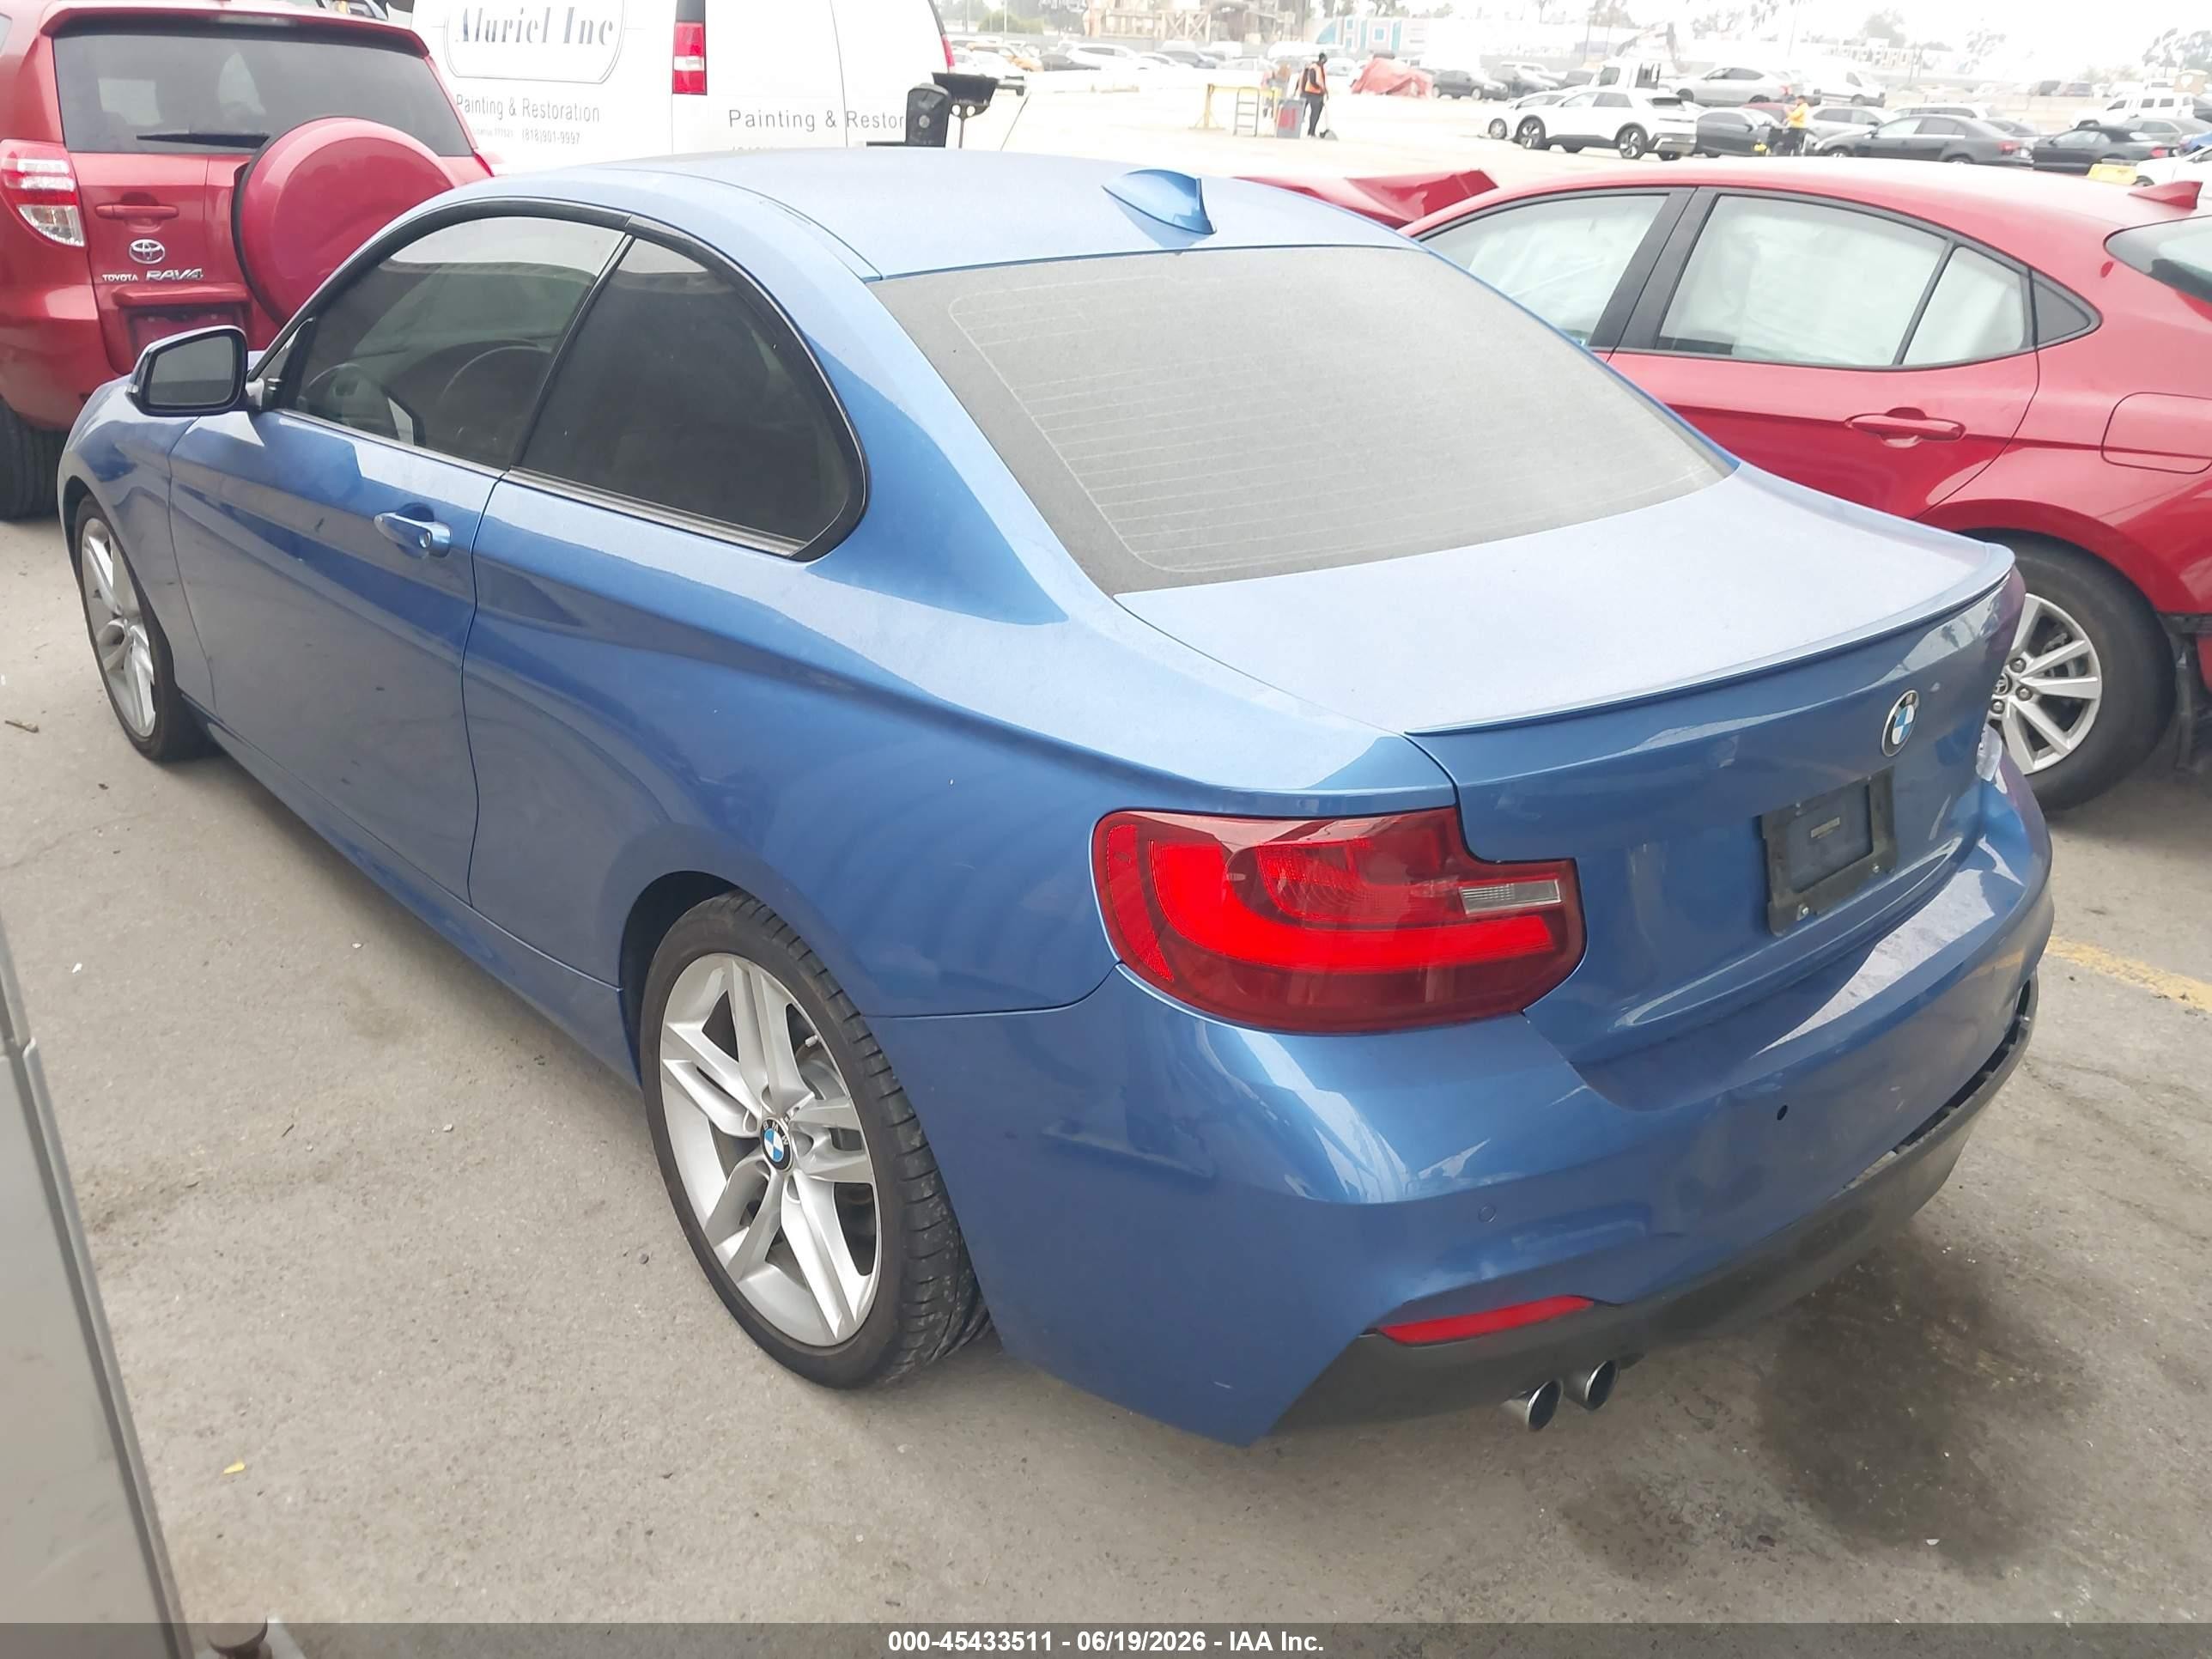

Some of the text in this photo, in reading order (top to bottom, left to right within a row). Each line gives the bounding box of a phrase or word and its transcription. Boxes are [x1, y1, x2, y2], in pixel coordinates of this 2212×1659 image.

[562, 6, 613, 46] Inc
[456, 94, 600, 122] Painting & Restoration
[728, 109, 815, 132] Painting
[824, 109, 837, 128] &
[102, 268, 204, 282] TOYOTA RAV4
[763, 1121, 789, 1146] BMW
